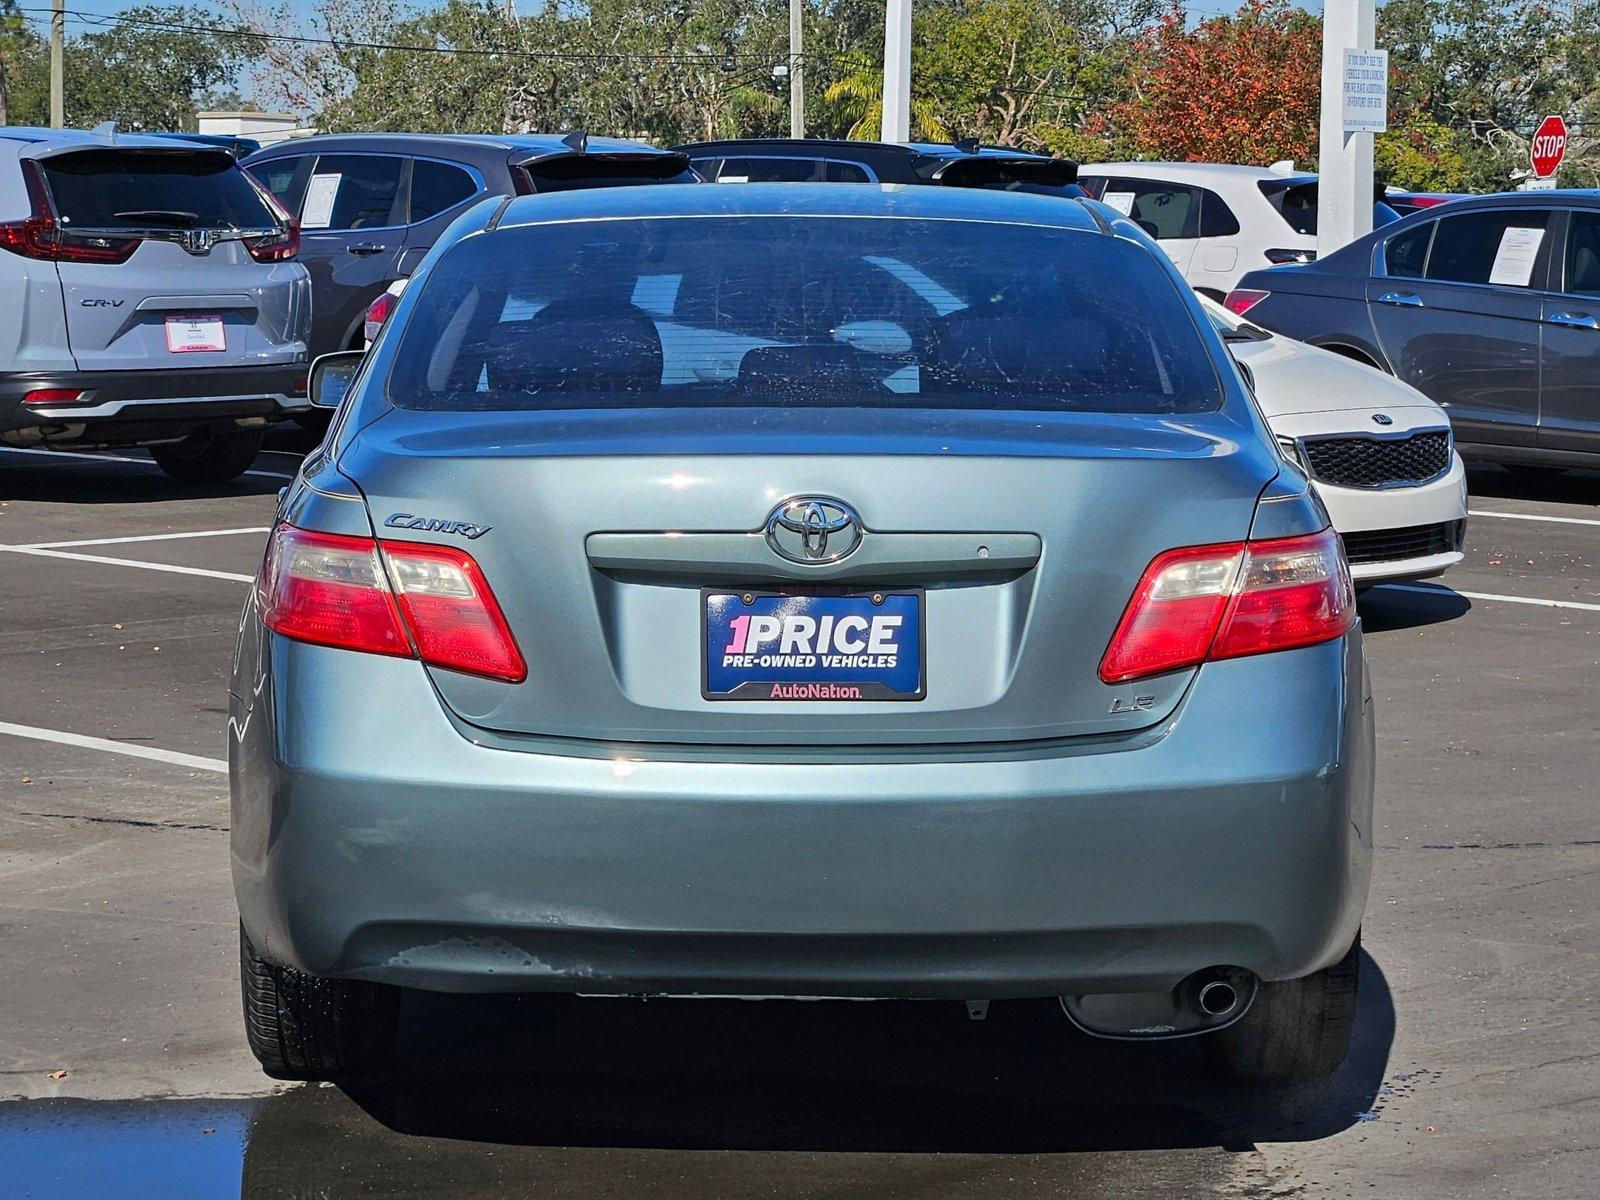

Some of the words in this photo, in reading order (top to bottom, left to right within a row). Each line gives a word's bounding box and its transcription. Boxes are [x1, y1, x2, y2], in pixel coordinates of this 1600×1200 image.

[1534, 135, 1564, 158] STOP
[80, 298, 125, 308] CR-V
[722, 655, 817, 668] PRE-OWNED
[821, 655, 898, 668] VEHICLES
[1109, 695, 1155, 714] LE
